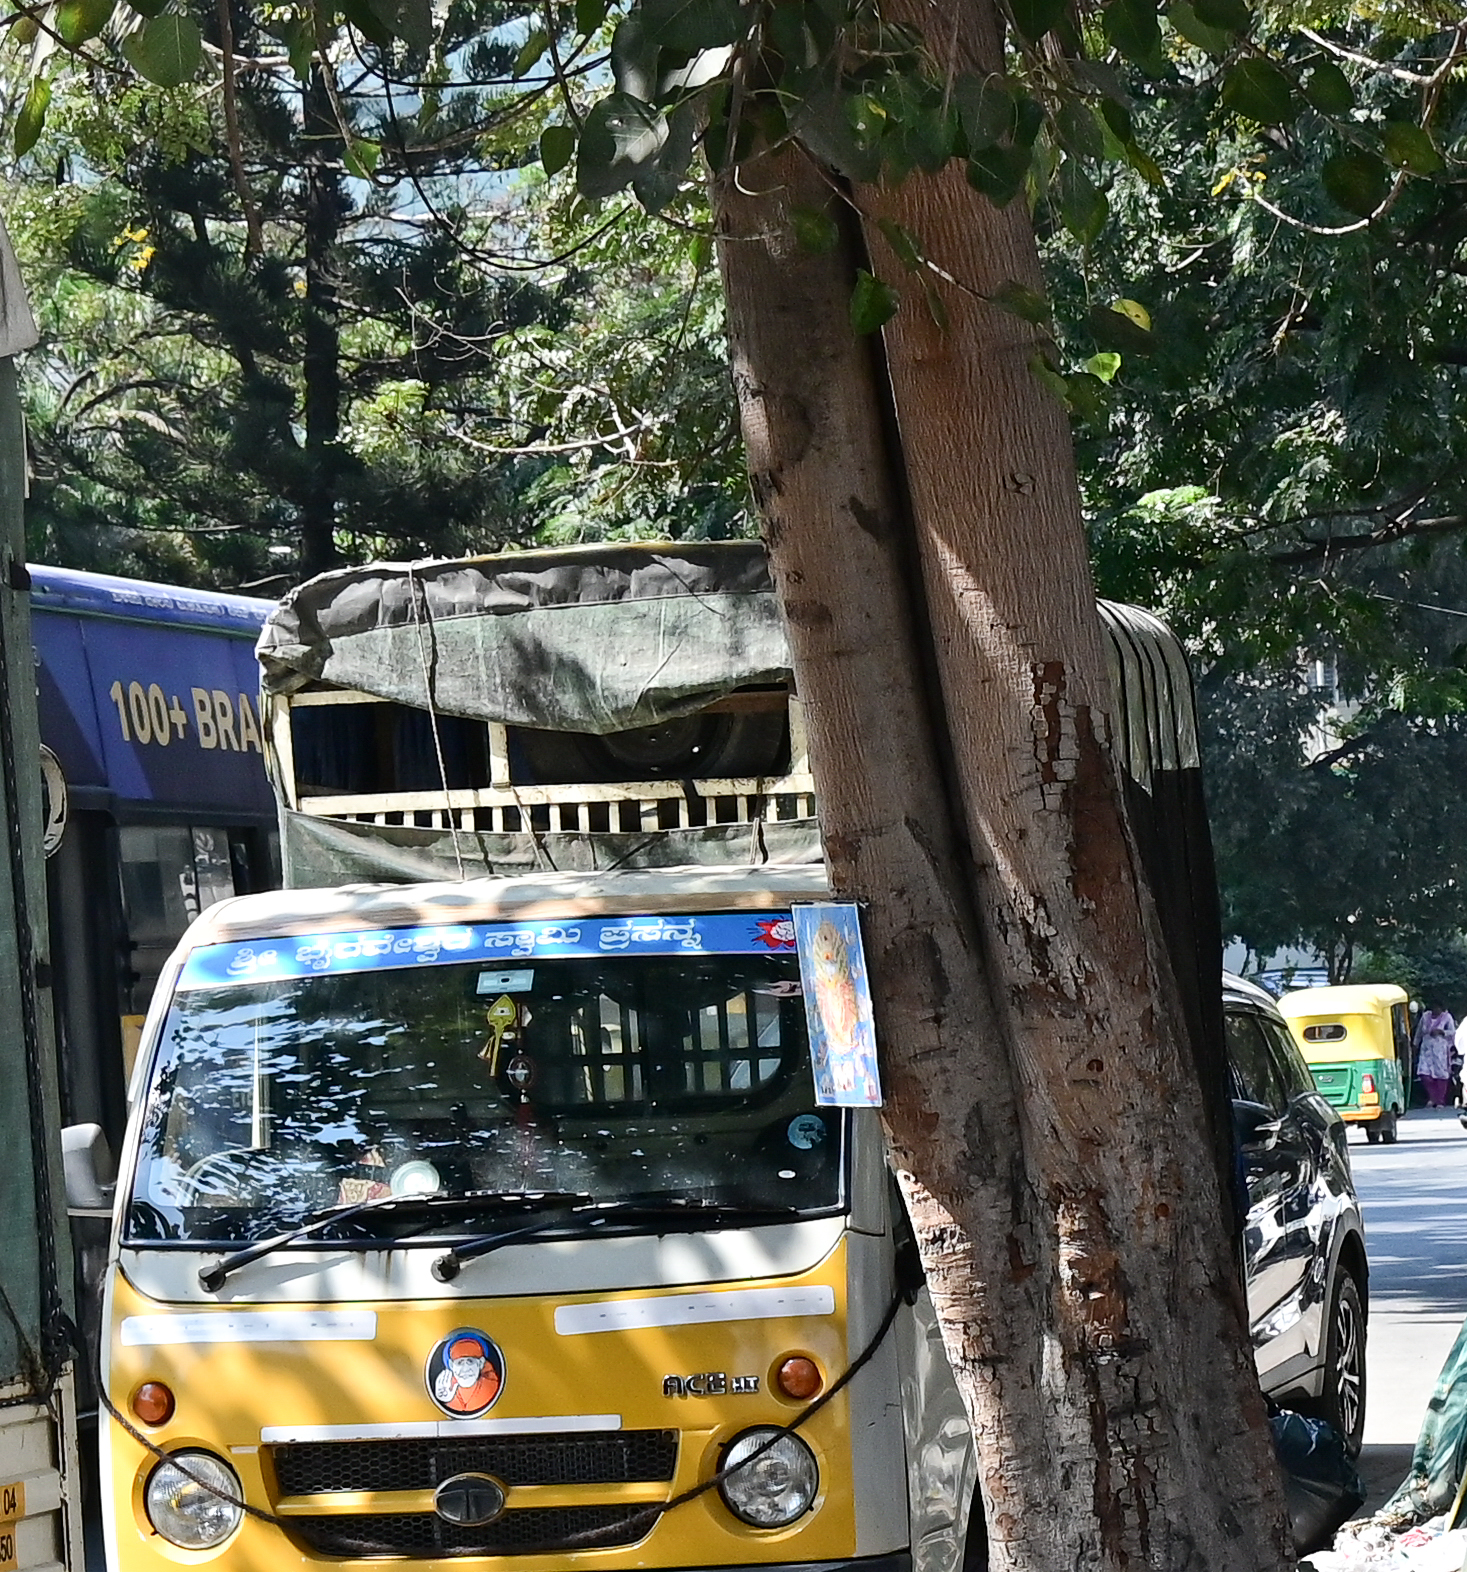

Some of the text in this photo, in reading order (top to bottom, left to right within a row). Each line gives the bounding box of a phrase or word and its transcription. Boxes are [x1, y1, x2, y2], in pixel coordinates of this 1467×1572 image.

[110, 680, 264, 753] 100+ BRA
[484, 925, 581, 957] ಸ್ವಾಮಿ
[599, 918, 703, 951] ಪ್ರಸನ್ನ
[662, 1372, 728, 1396] ACE
[4, 1486, 17, 1516] 04
[0, 1533, 13, 1563] 50
